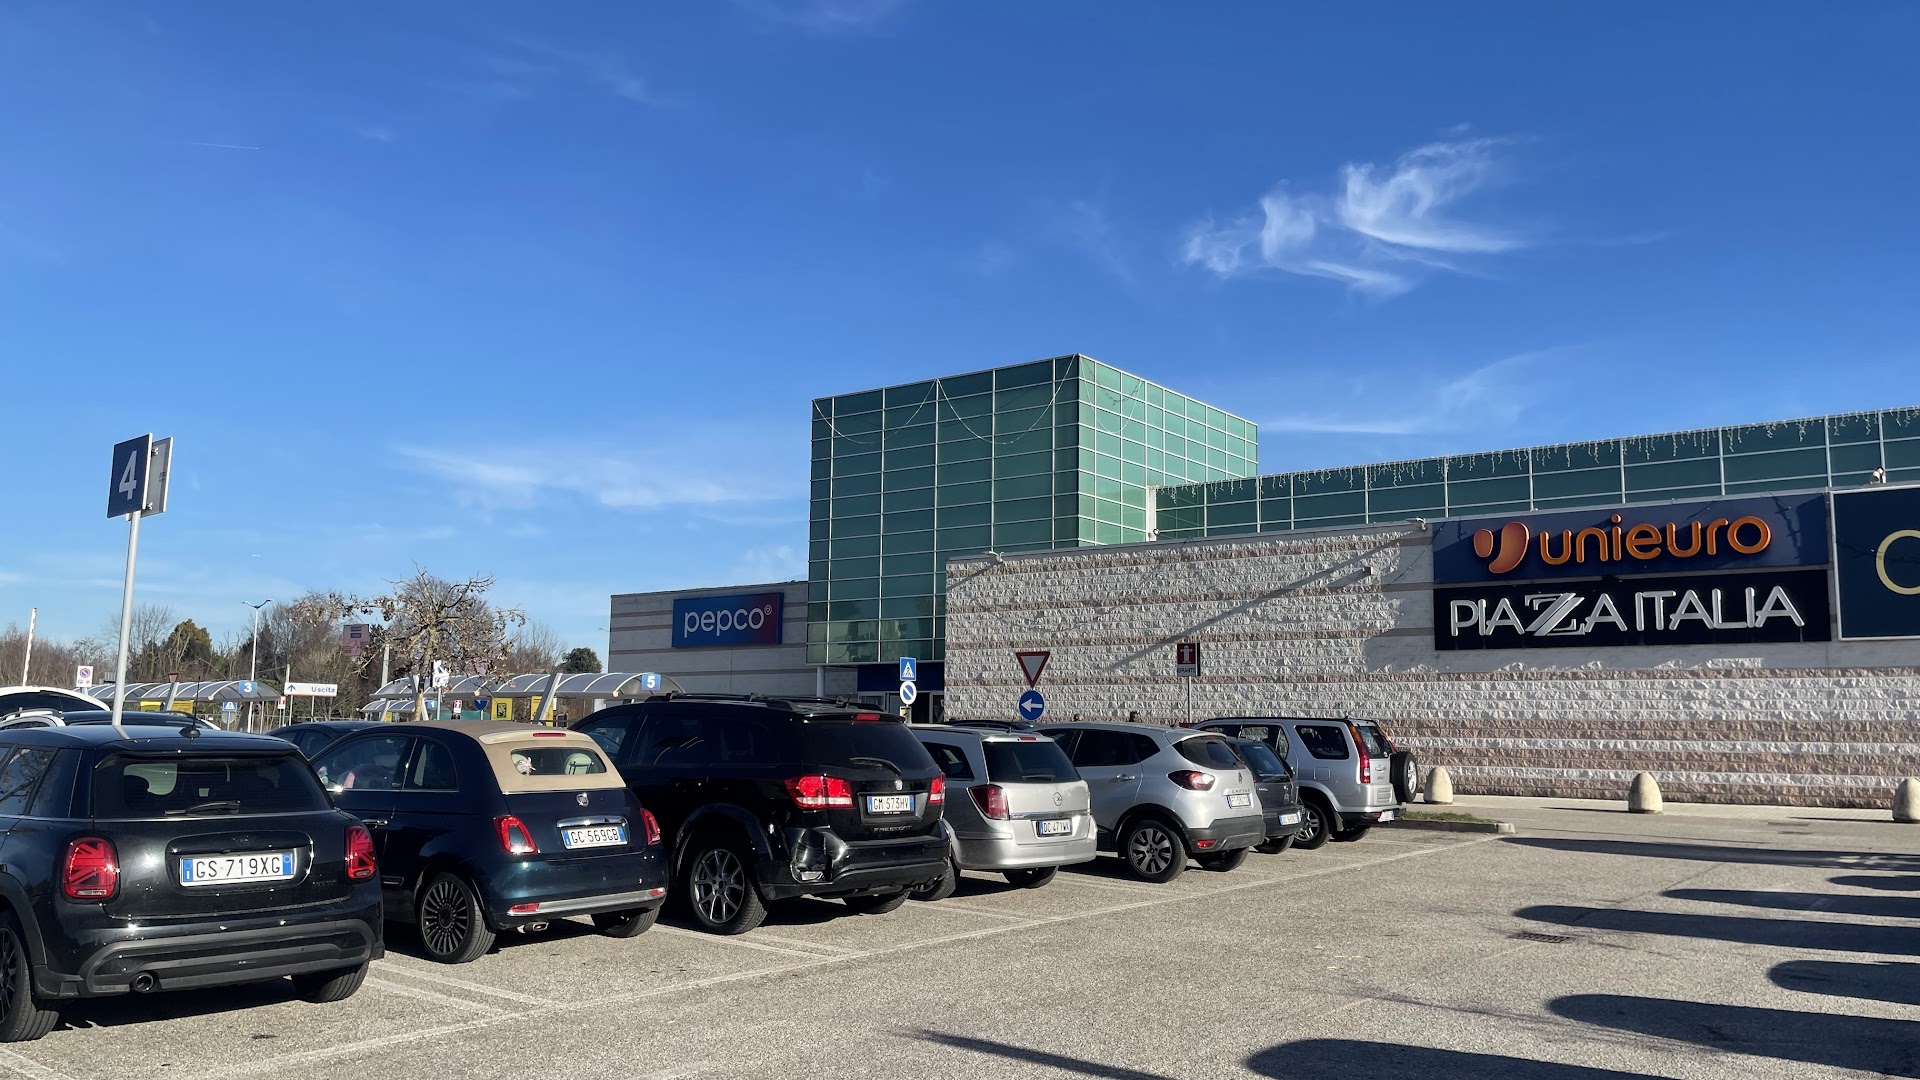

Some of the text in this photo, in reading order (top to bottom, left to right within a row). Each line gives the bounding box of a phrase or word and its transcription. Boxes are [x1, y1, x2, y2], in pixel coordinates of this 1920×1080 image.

[119, 450, 137, 500] 4
[1540, 513, 1772, 565] unieuro
[1450, 585, 1805, 636] PIAZZA ITALIA
[243, 682, 253, 693] 3
[647, 675, 655, 689] 5
[570, 828, 619, 844] GC 569GB
[196, 861, 217, 878] GS
[225, 858, 280, 876] 719XG
